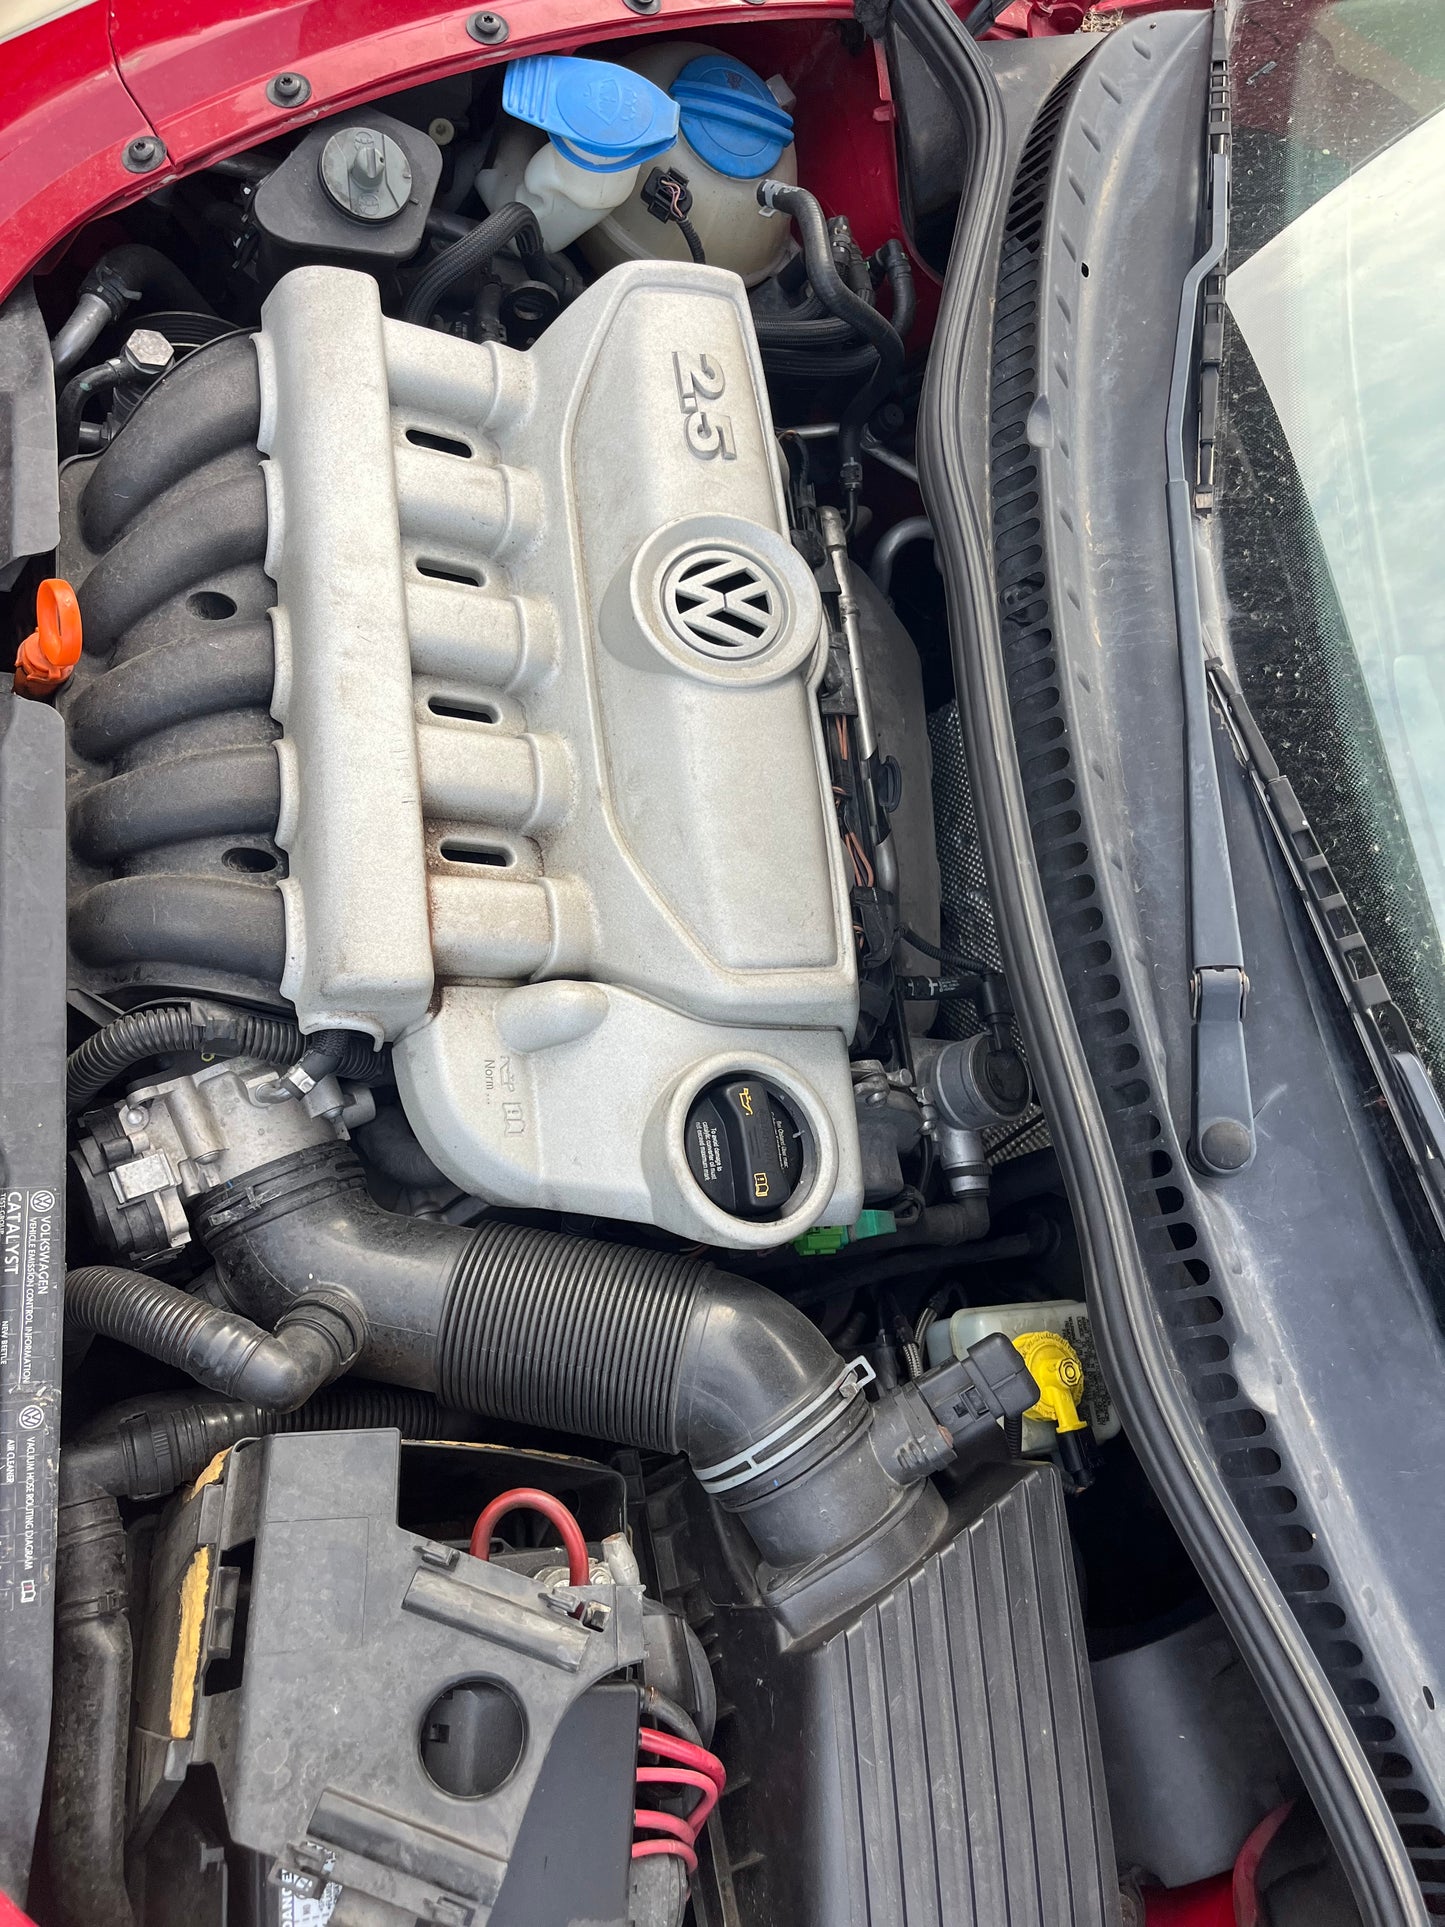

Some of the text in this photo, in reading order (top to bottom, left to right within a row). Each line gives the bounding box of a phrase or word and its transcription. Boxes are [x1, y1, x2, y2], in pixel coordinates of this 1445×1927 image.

[671, 351, 738, 460] 2.5
[662, 550, 783, 661] VW
[484, 1059, 495, 1090] Norm
[4, 1191, 22, 1275] CATALYST
[37, 1215, 51, 1295] VOLKSWAGEN
[0, 1320, 9, 1365] NEW BEETLE
[23, 1217, 37, 1384] VEHICLE EMISSION CONTROL INFORMATION
[6, 1439, 15, 1484] AIR CLEANER
[24, 1436, 35, 1570] VACUUM HOSE ROUTING DIAGRAM
